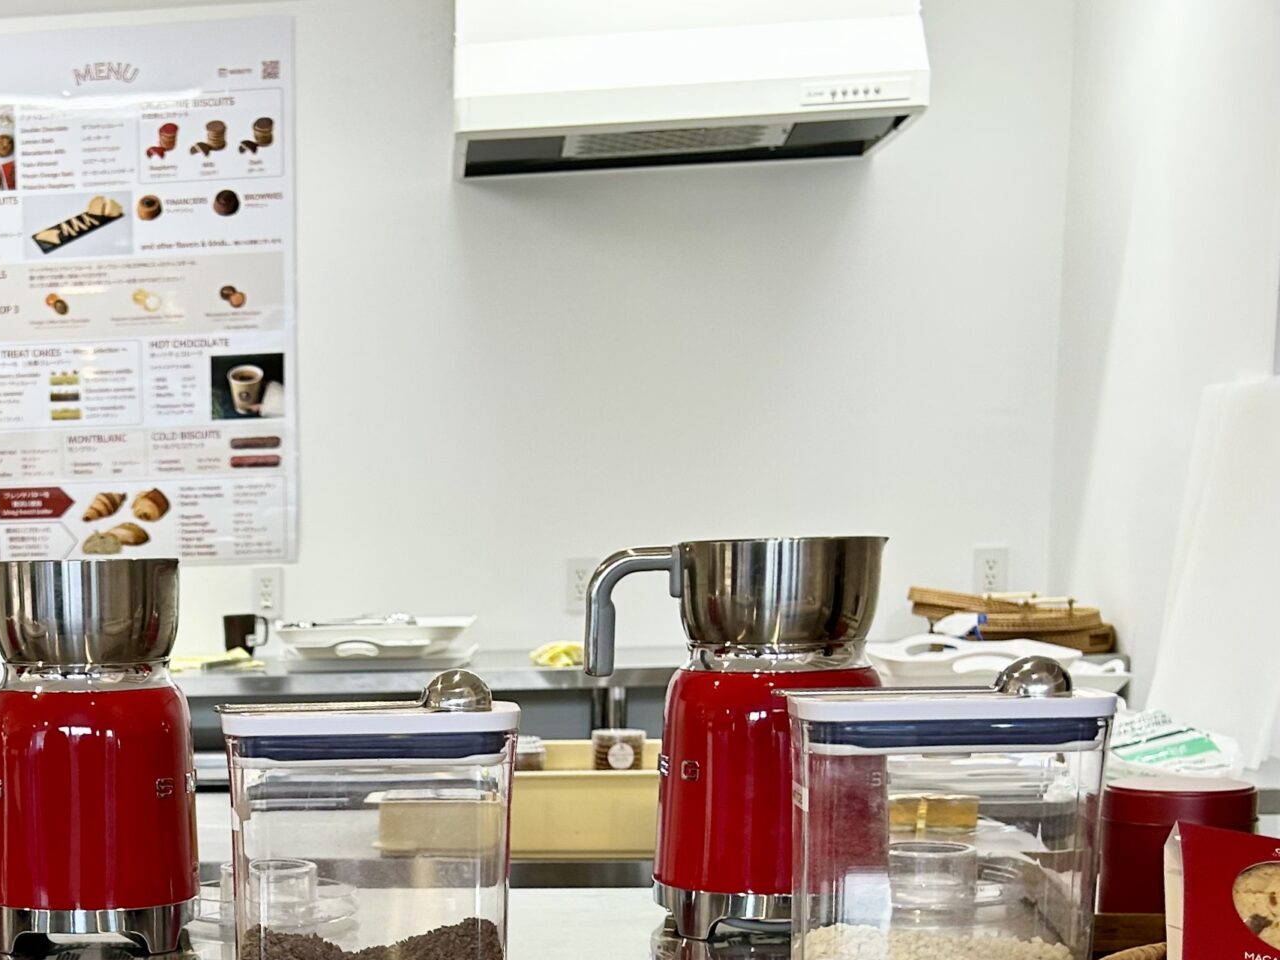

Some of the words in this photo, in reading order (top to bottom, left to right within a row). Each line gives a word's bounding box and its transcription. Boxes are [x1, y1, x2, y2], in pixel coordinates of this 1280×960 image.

[73, 61, 140, 86] MENU
[192, 97, 235, 107] BISCUITS
[245, 192, 284, 201] BROWNIES
[150, 340, 170, 349] HOT
[172, 338, 231, 348] CHOCOLATE
[1, 349, 29, 359] TREAT
[33, 348, 62, 358] CAKES
[67, 433, 128, 444] MONTBLANC
[151, 431, 177, 441] COLD
[180, 429, 221, 440] BISCUITS
